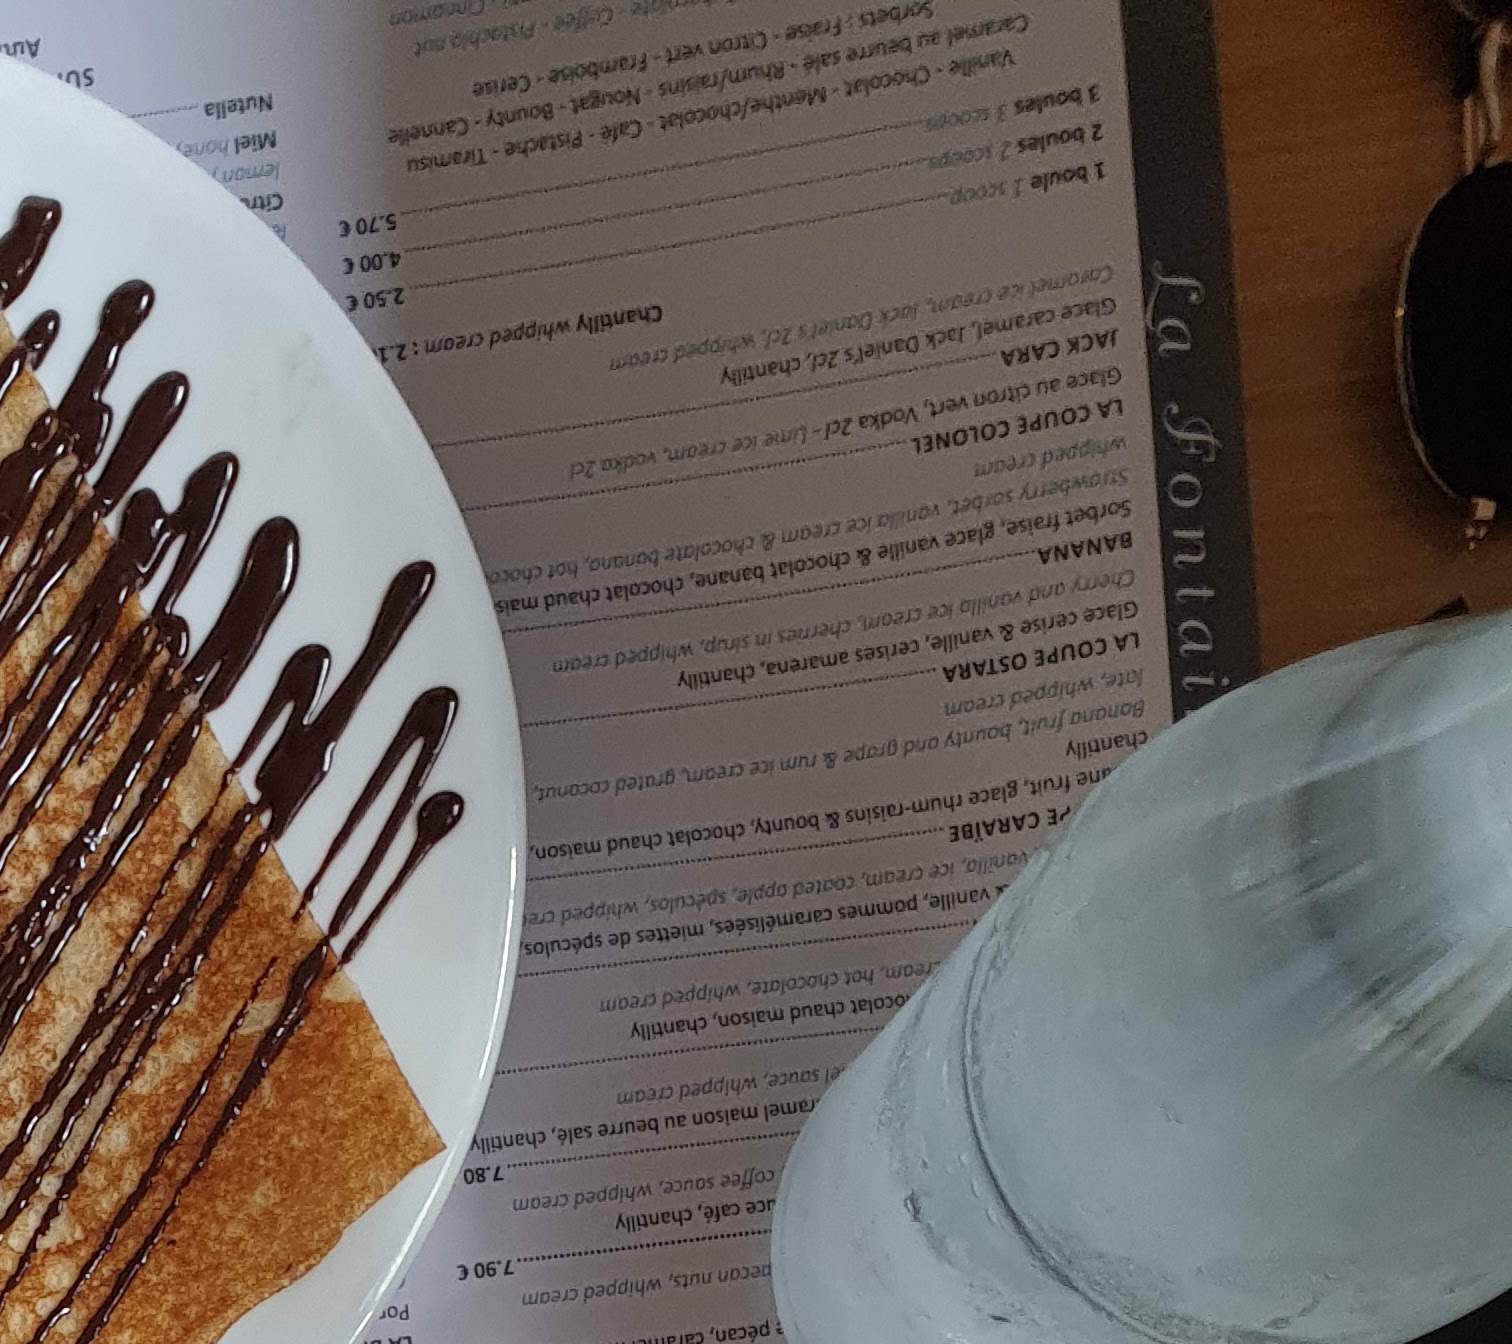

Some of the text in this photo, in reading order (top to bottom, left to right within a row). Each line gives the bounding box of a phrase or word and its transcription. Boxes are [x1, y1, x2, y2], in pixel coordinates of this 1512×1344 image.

[203, 93, 273, 121] Nutella
[233, 130, 277, 155] Miel
[338, 213, 397, 238] 5.70 €
[345, 287, 405, 313] 2.50 €
[425, 305, 663, 354] Chantilly whipped cream
[1000, 328, 1119, 367] JACK CARA
[910, 398, 1124, 456] LA COUPE COLONEL
[1038, 530, 1133, 565] BANANA
[942, 631, 1141, 683] LA COUPE OSTARA
[615, 1203, 741, 1234] café, chantilly
[709, 1319, 771, 1344] pécan,
